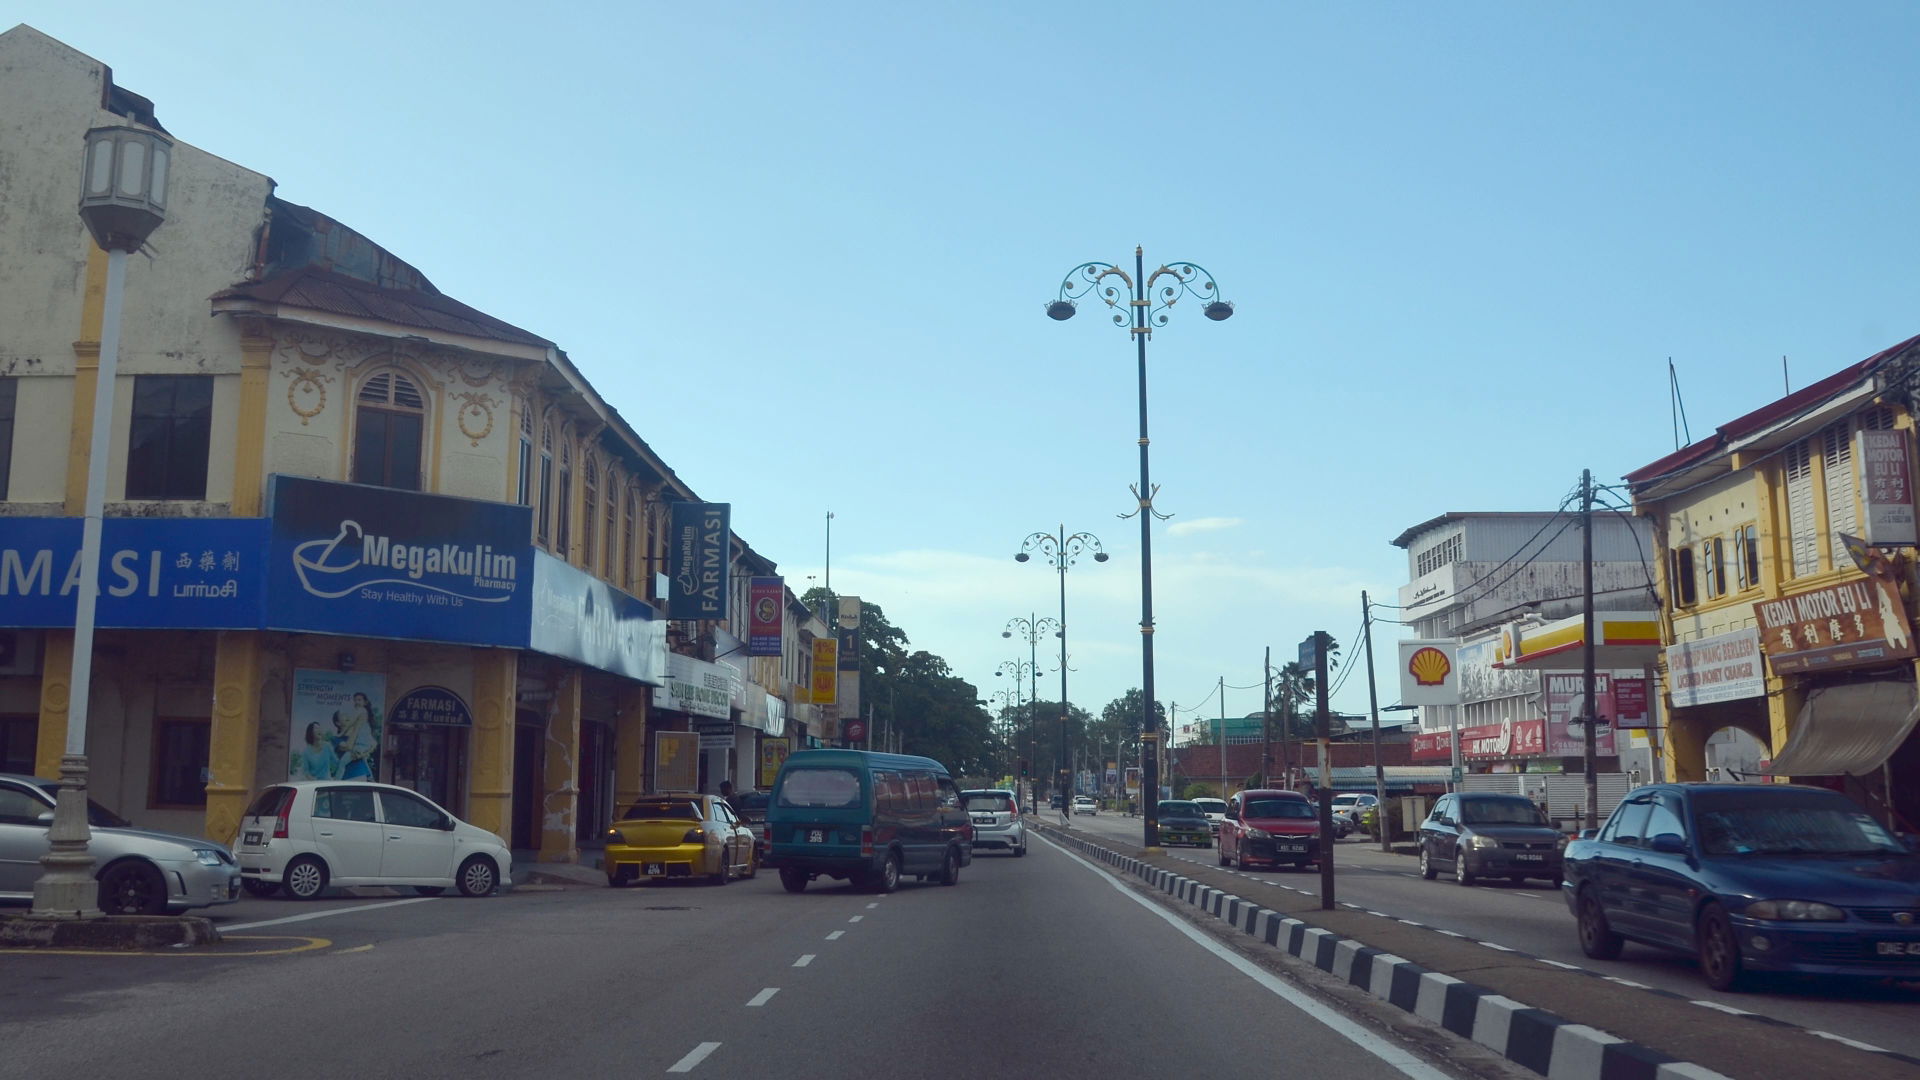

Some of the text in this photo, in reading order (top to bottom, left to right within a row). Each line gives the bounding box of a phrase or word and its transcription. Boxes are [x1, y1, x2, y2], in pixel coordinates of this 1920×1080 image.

[1868, 435, 1900, 449] KEDAI
[1867, 448, 1904, 462] MOTOR
[1874, 463, 1900, 476] EU LI
[363, 534, 516, 580] MegaKulim
[702, 511, 721, 611] FARMASI
[473, 576, 517, 593] Pharmacy
[361, 588, 464, 607] Stay Healthy With Us
[1762, 582, 1872, 629] KEDAI MOTOR EU LI
[1550, 676, 1607, 693] MURH
[407, 698, 457, 712] FARMASI
[1472, 740, 1480, 754] HK
